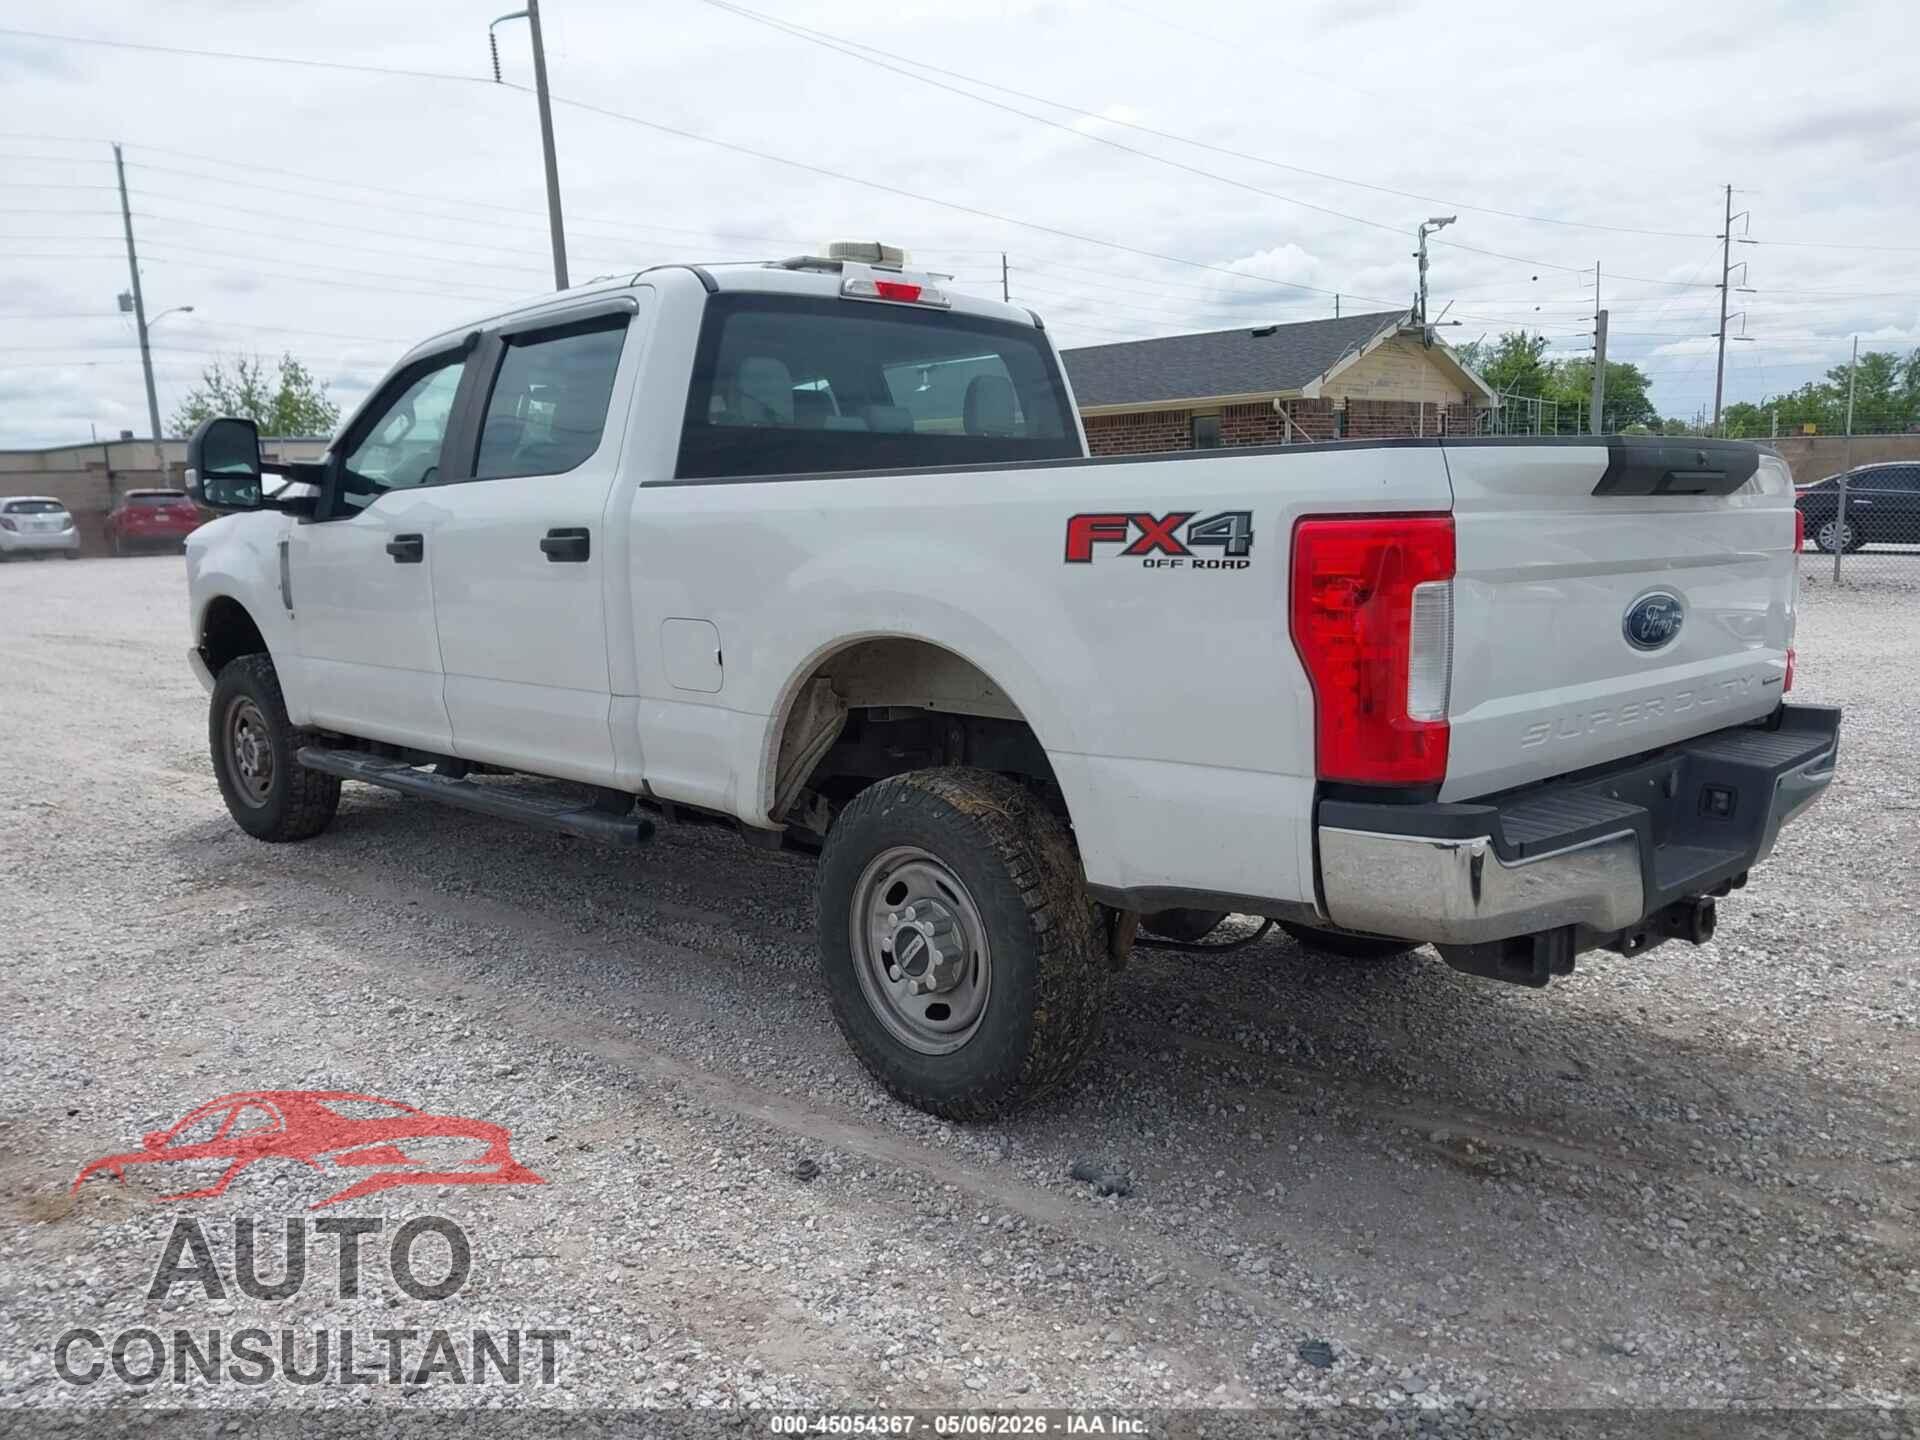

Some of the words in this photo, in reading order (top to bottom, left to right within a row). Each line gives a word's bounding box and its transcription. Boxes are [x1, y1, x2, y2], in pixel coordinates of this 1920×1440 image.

[1064, 510, 1254, 563] FX4
[1142, 558, 1184, 569] OFF
[1191, 558, 1250, 570] ROAD
[1520, 696, 1665, 750] SUPER
